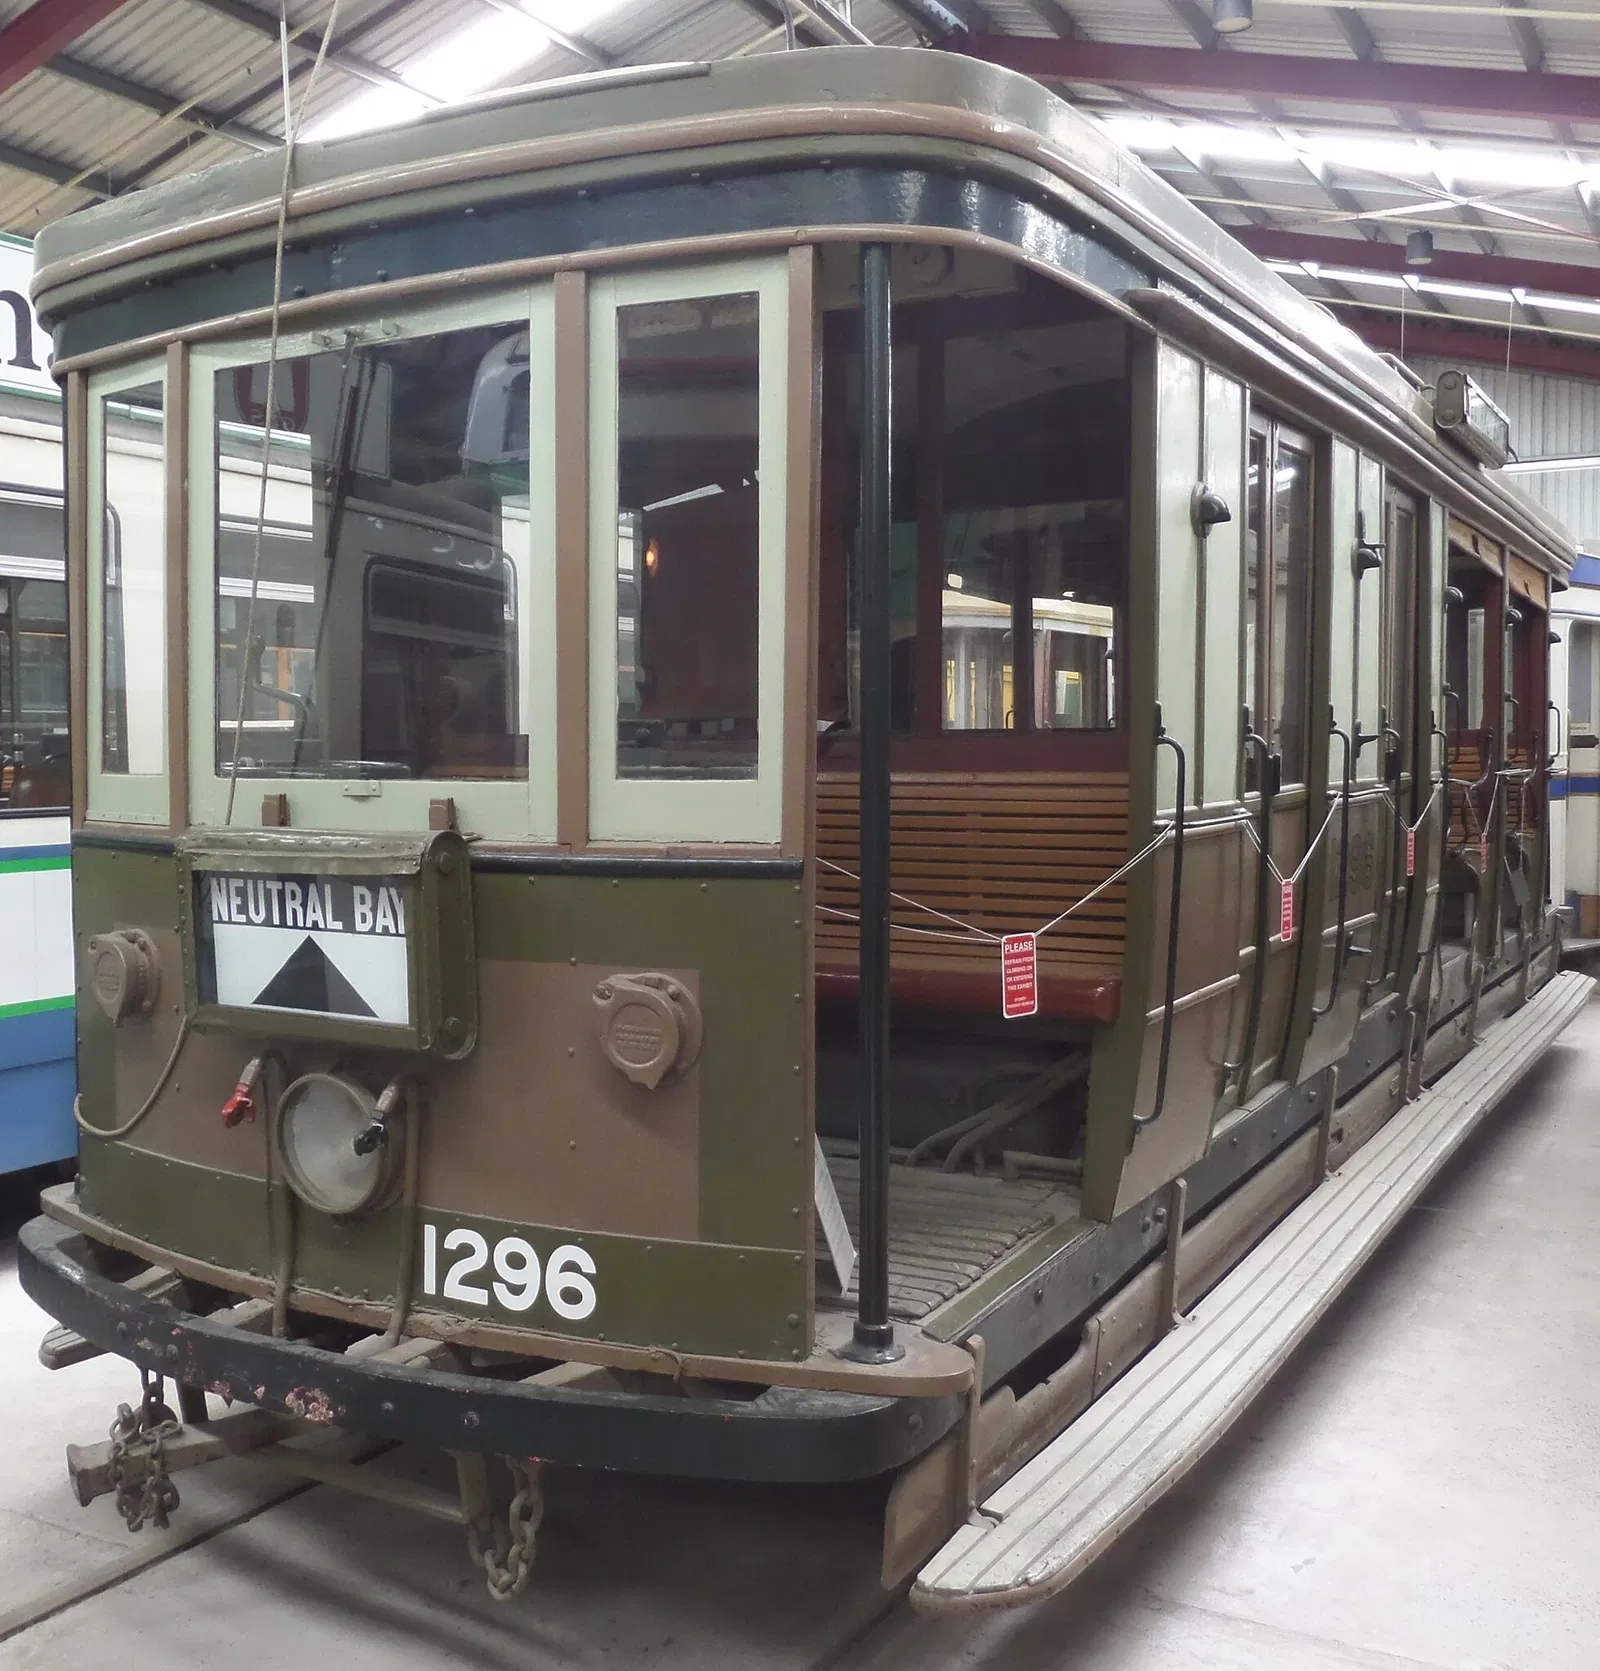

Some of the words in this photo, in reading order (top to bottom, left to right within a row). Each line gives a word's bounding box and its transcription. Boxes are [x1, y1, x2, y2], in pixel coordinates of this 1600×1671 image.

[210, 877, 343, 931] NEUTRAL
[352, 885, 406, 935] BAY
[1005, 941, 1033, 954] PLEASE
[423, 1223, 598, 1320] 1296
